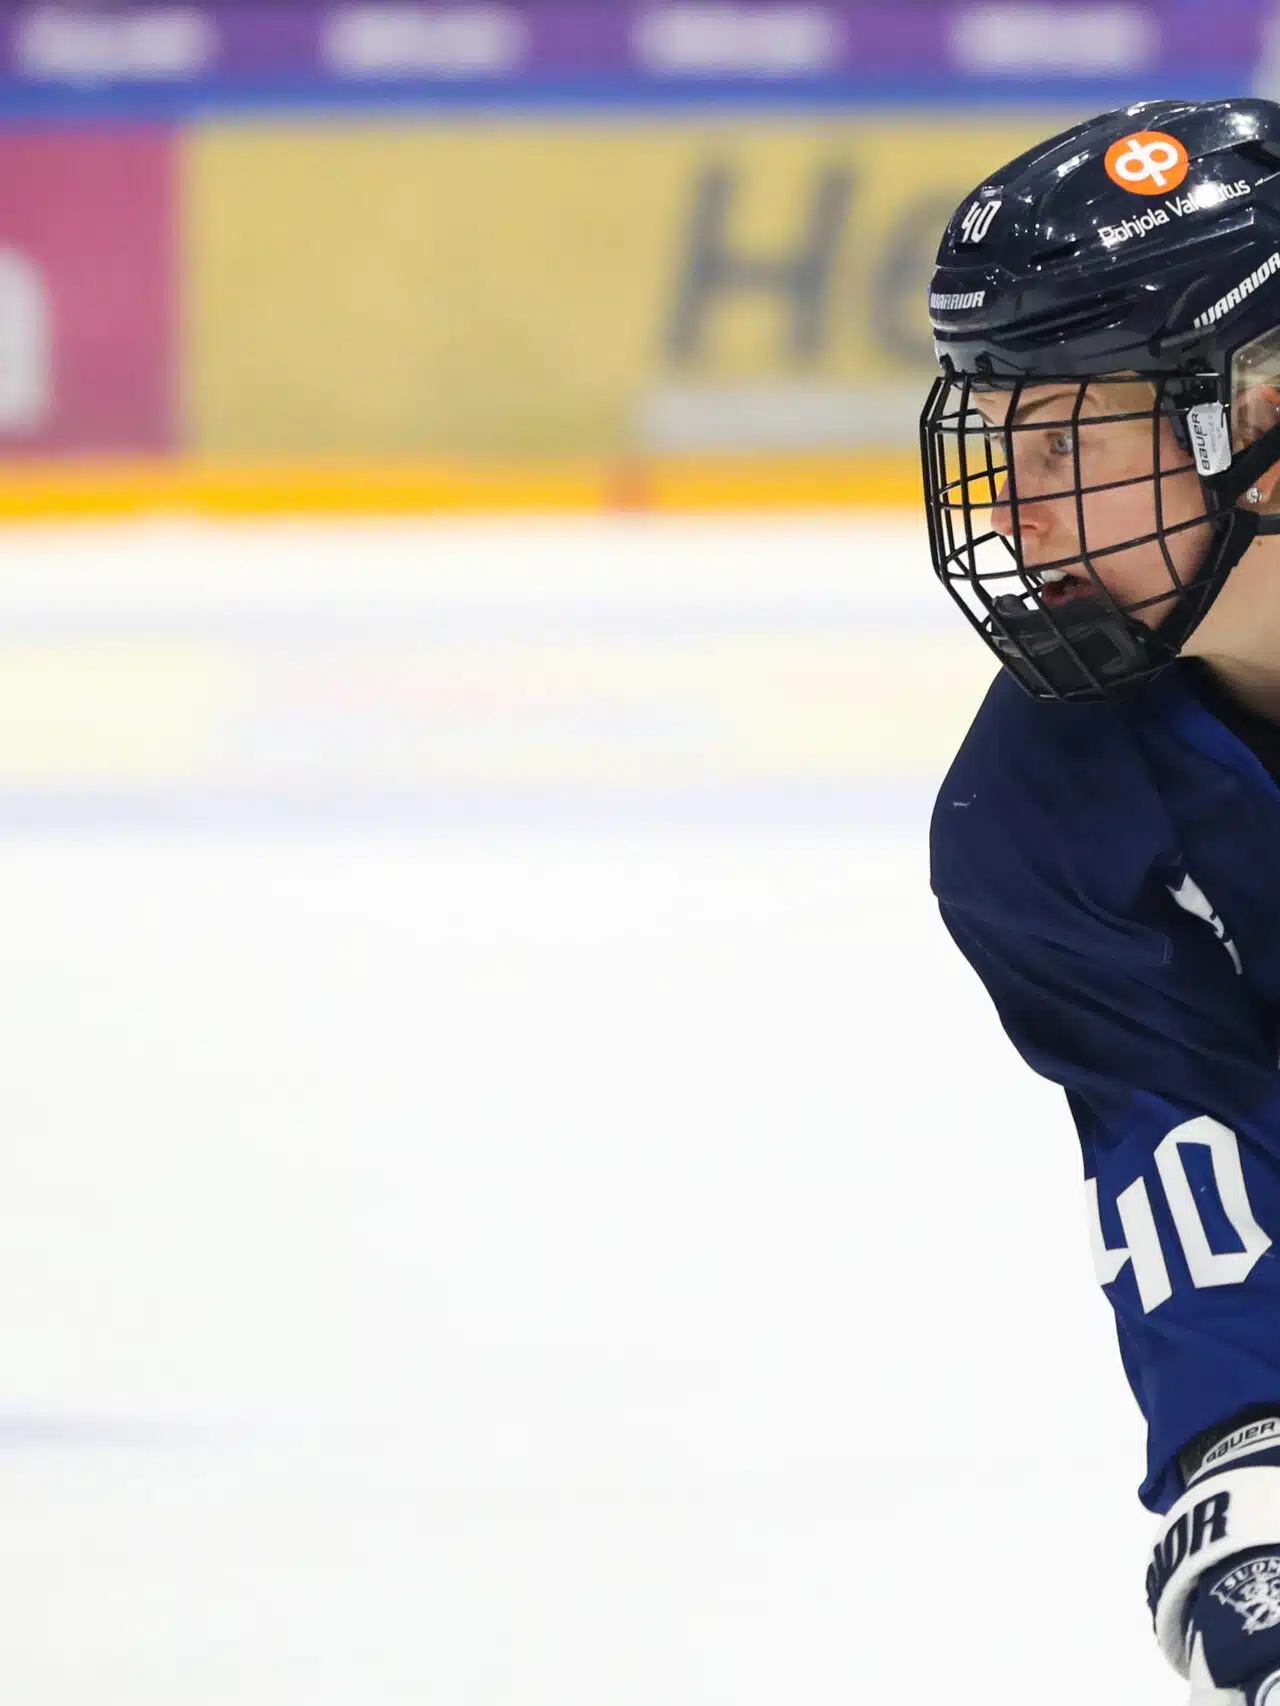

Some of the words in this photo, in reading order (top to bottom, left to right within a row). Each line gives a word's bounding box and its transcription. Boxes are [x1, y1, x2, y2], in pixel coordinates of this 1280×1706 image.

[961, 200, 1002, 243] 40
[1098, 208, 1171, 247] Pohjola
[1165, 179, 1251, 217] Vatus
[930, 290, 985, 309] WARRIOR
[1084, 1115, 1273, 1315] 40
